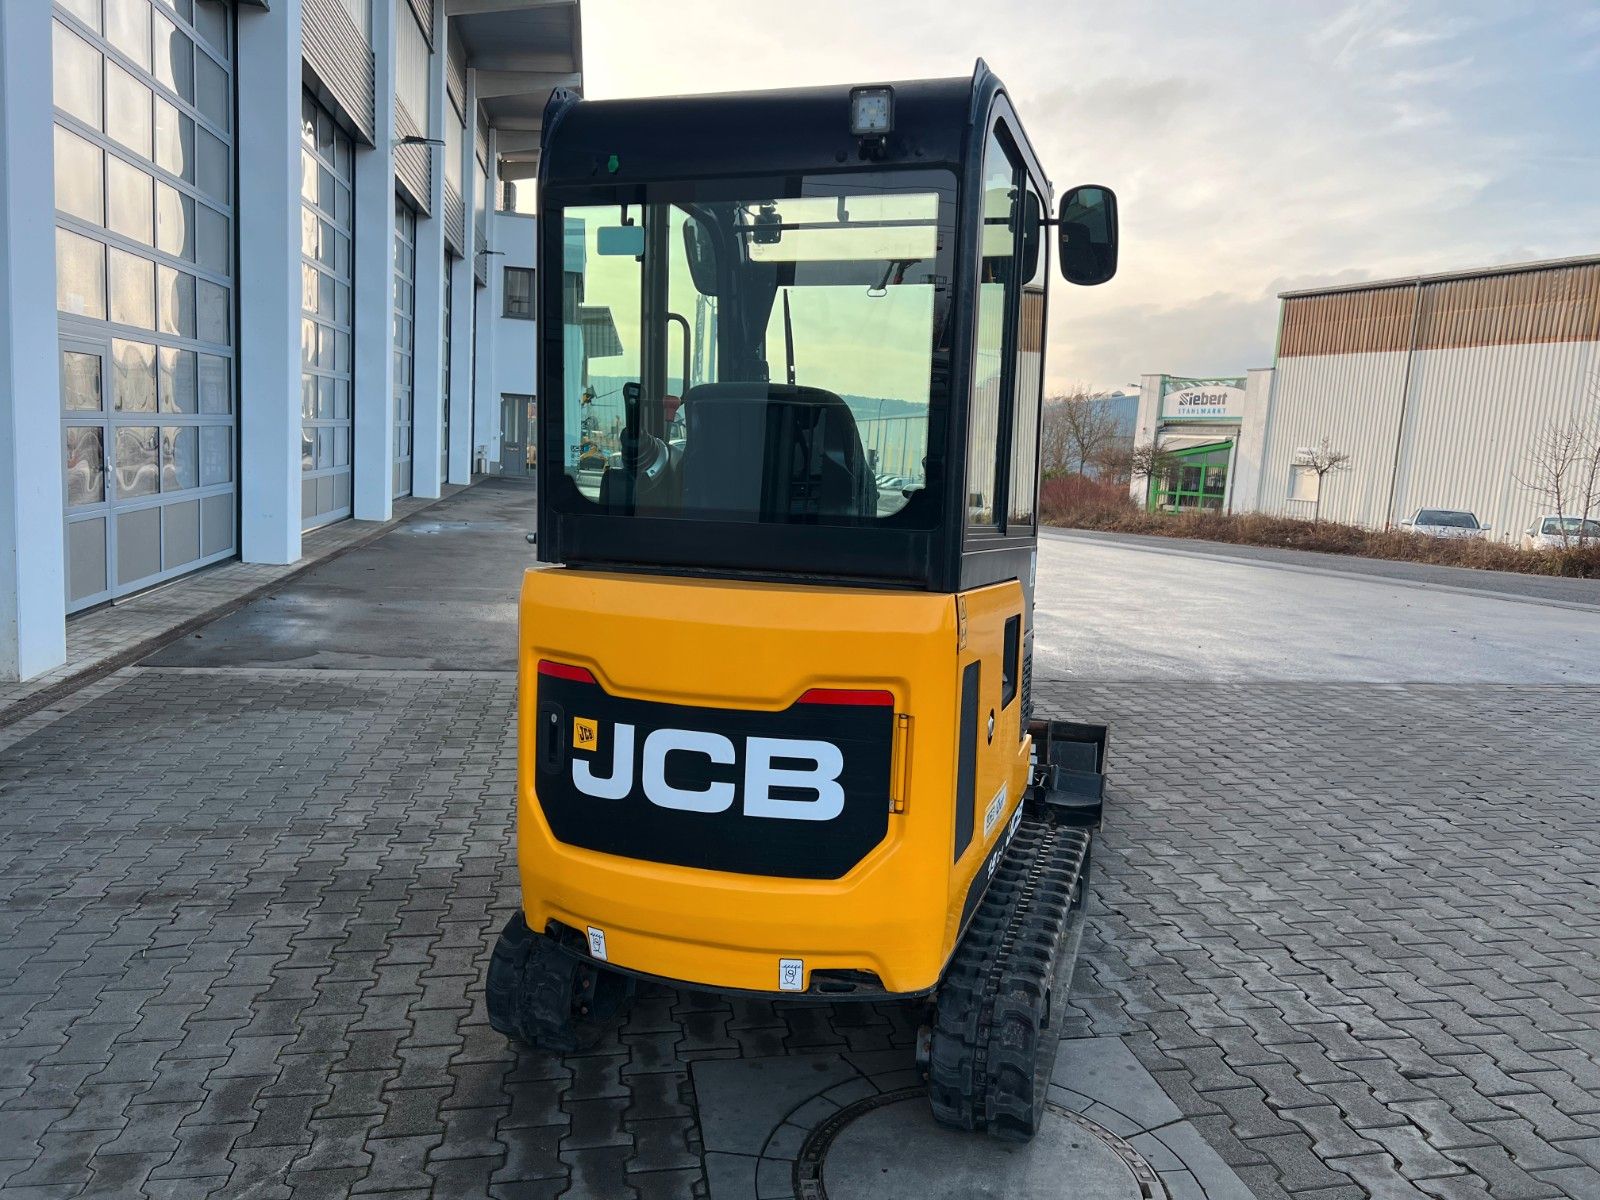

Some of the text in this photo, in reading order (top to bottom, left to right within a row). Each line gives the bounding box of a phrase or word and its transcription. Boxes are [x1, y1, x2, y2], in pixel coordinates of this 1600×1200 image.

[1179, 392, 1227, 405] Siebert
[1178, 407, 1226, 415] STAHLMARKT
[572, 722, 845, 821] JCB
